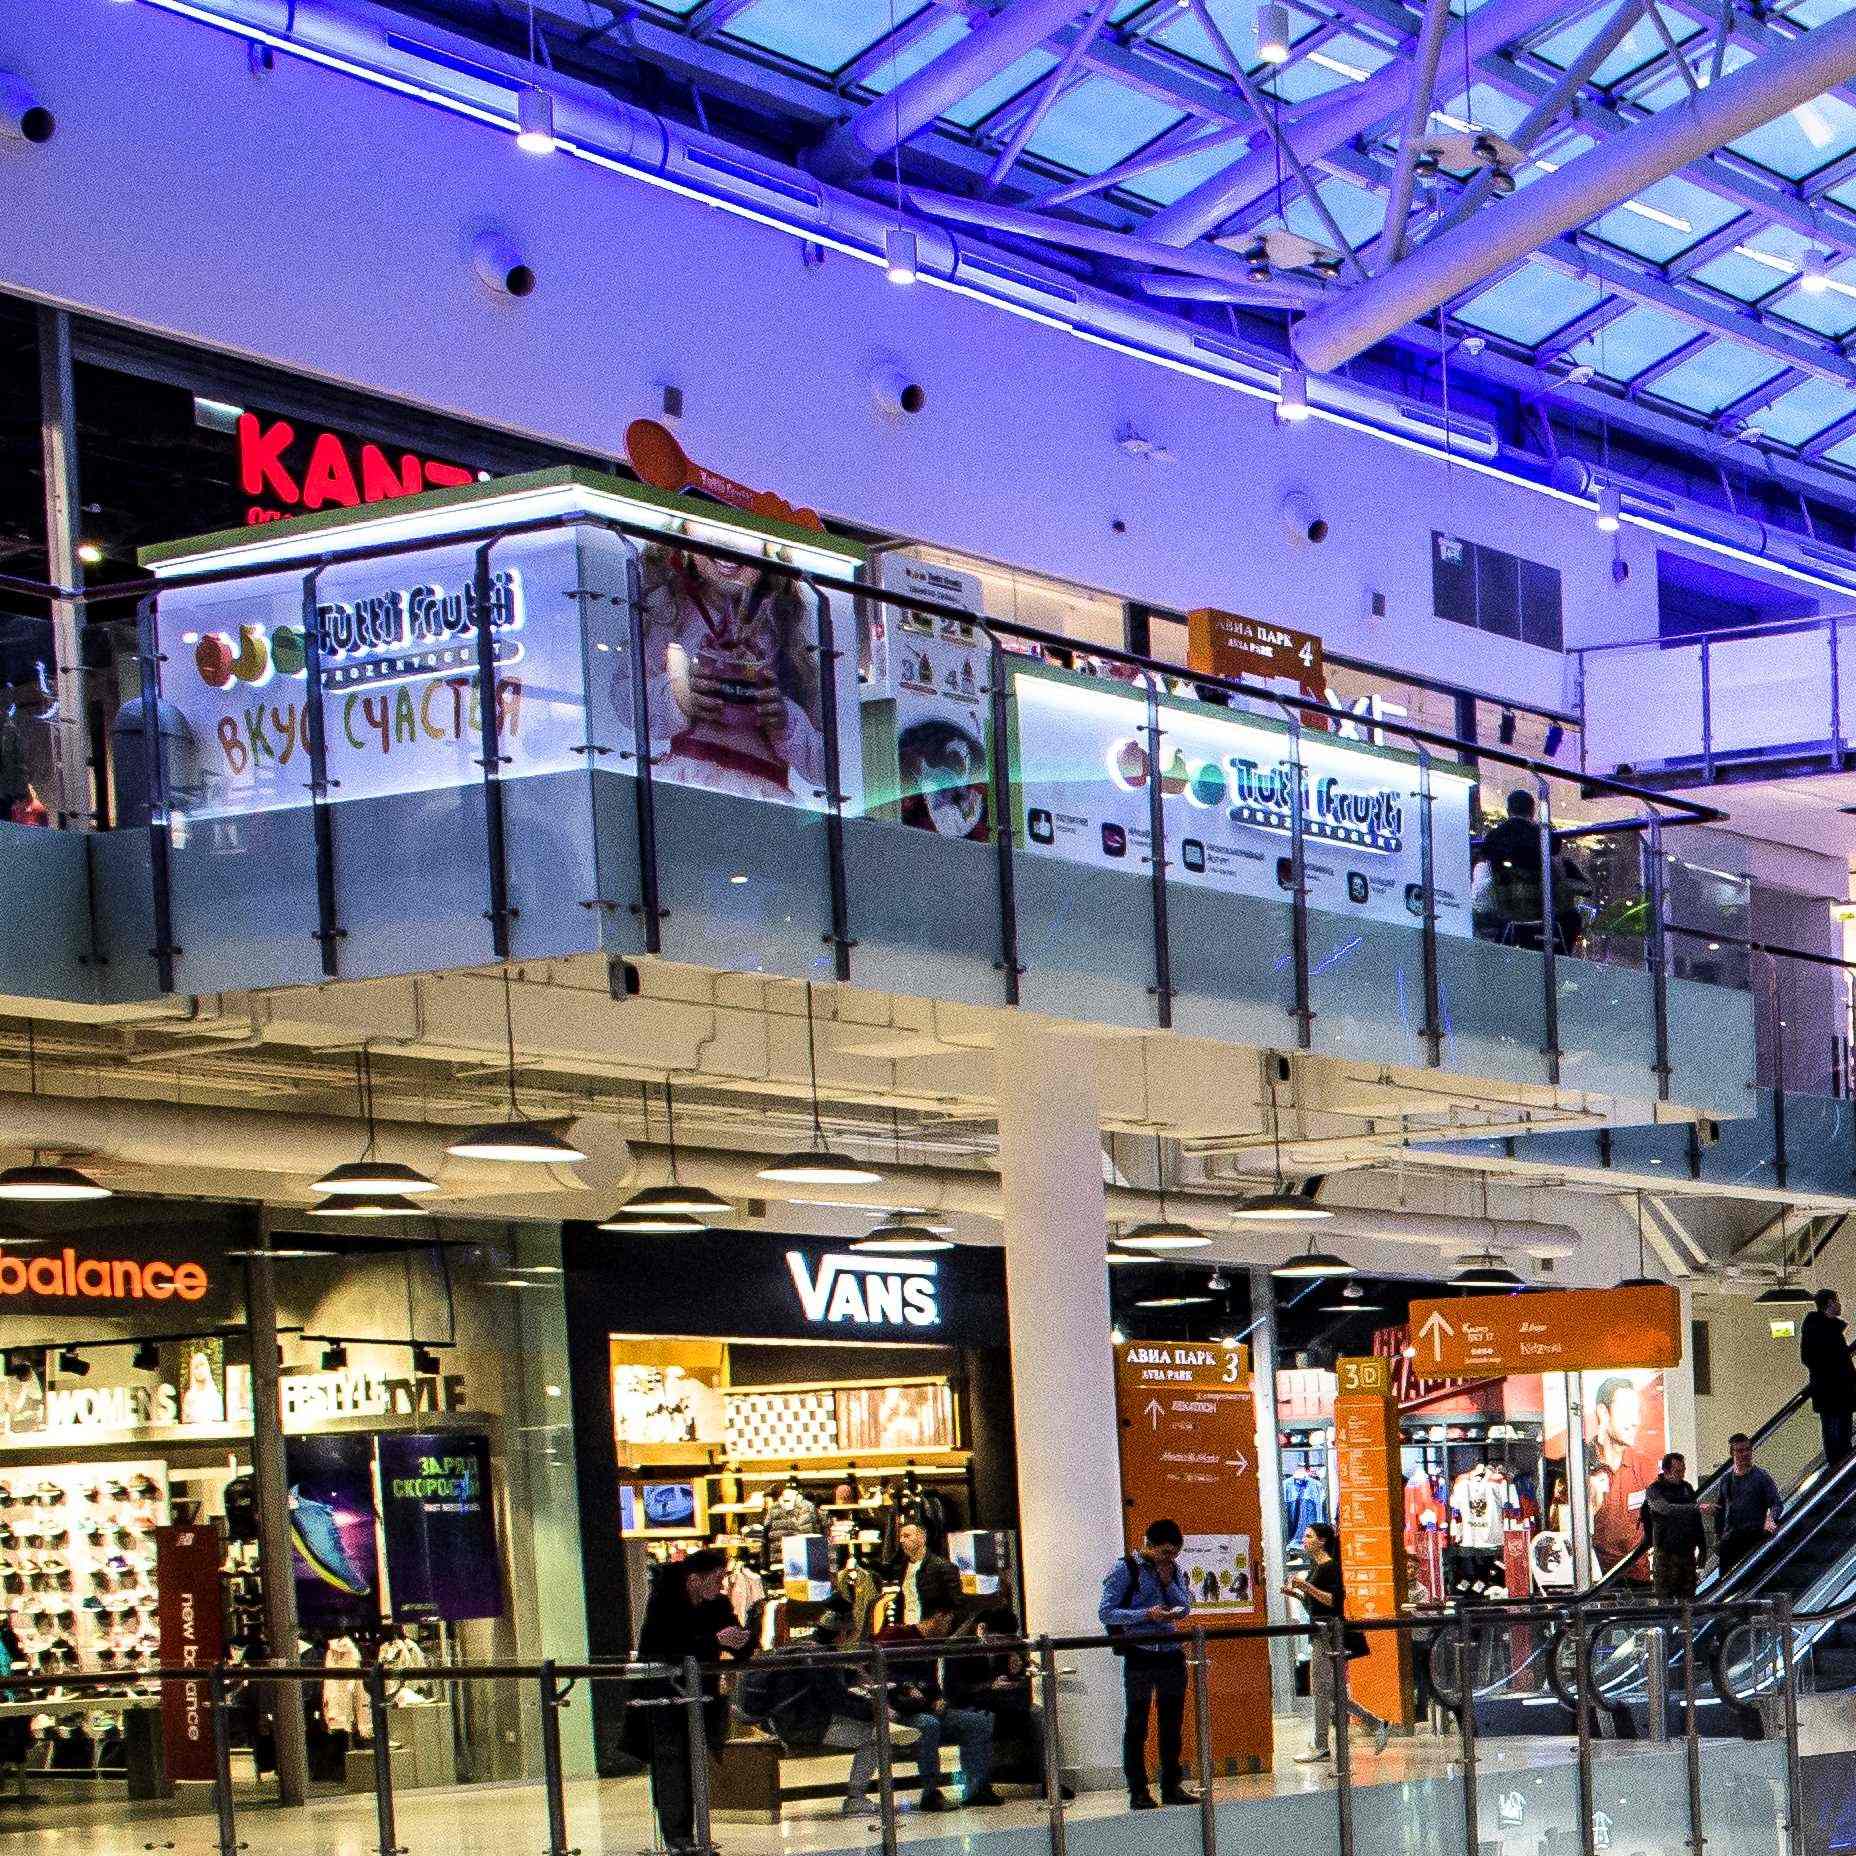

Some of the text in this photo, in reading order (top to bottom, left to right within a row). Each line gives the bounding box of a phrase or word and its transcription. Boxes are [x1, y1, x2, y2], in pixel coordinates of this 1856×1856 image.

[1298, 641, 1314, 667] 4
[0, 1249, 208, 1300] balance
[785, 1250, 938, 1326] VANS
[1127, 1349, 1239, 1383] АВИА ПАРК 3
[181, 1593, 200, 1741] new baance
